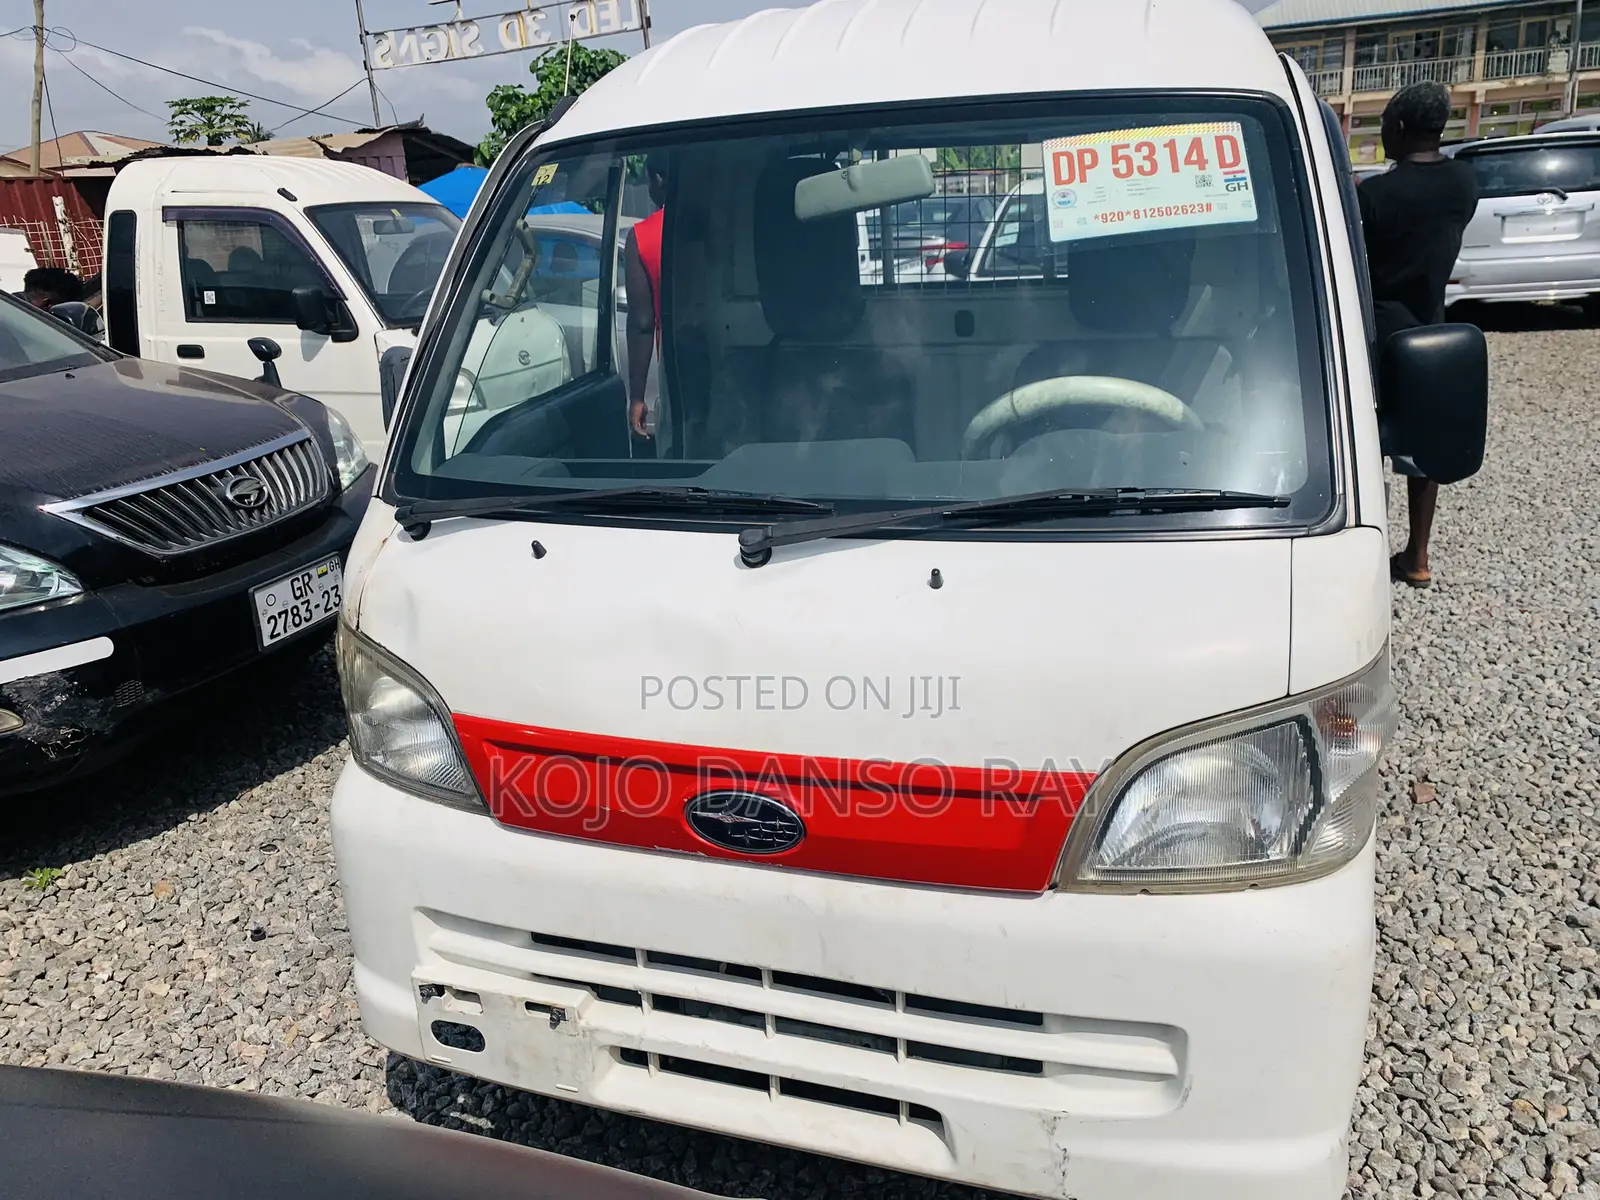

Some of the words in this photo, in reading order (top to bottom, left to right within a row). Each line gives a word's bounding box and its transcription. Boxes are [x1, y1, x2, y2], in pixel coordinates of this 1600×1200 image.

[1052, 148, 1099, 186] DP
[1111, 137, 1208, 179] 5314
[1214, 135, 1241, 169] D
[536, 174, 550, 184] 12
[1225, 181, 1249, 192] GH
[329, 558, 341, 572] GH
[290, 572, 314, 601] GR
[267, 584, 341, 640] 2783-23
